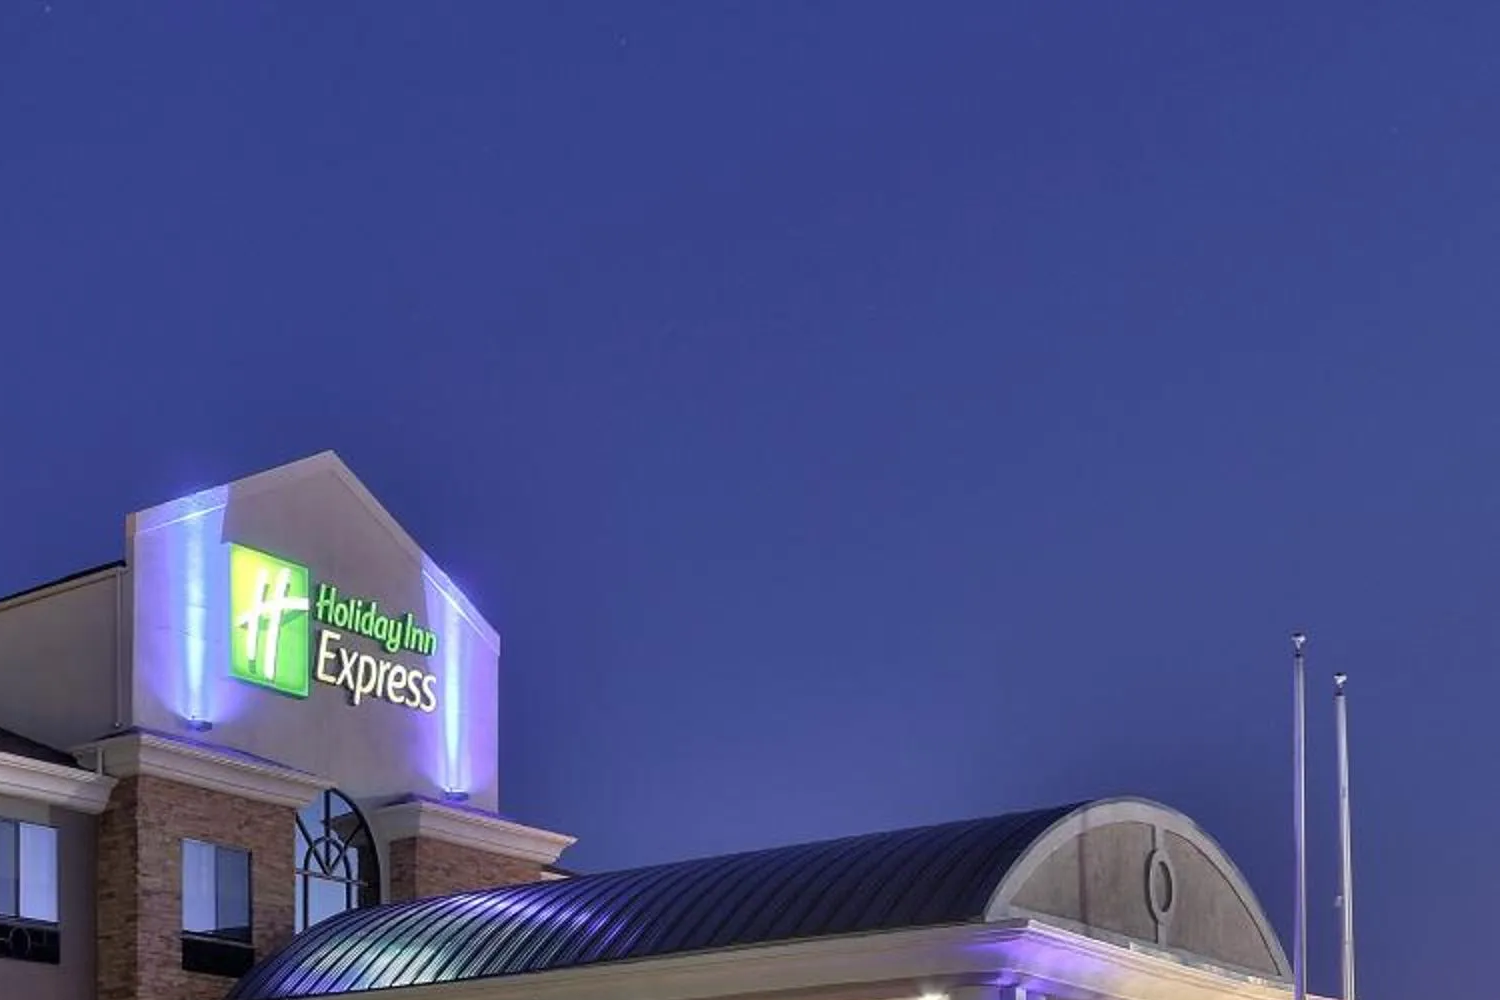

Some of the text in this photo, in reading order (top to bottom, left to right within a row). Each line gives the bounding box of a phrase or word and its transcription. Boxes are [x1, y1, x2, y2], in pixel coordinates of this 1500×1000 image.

[316, 583, 437, 656] Holiday Inn
[315, 629, 437, 713] Express
